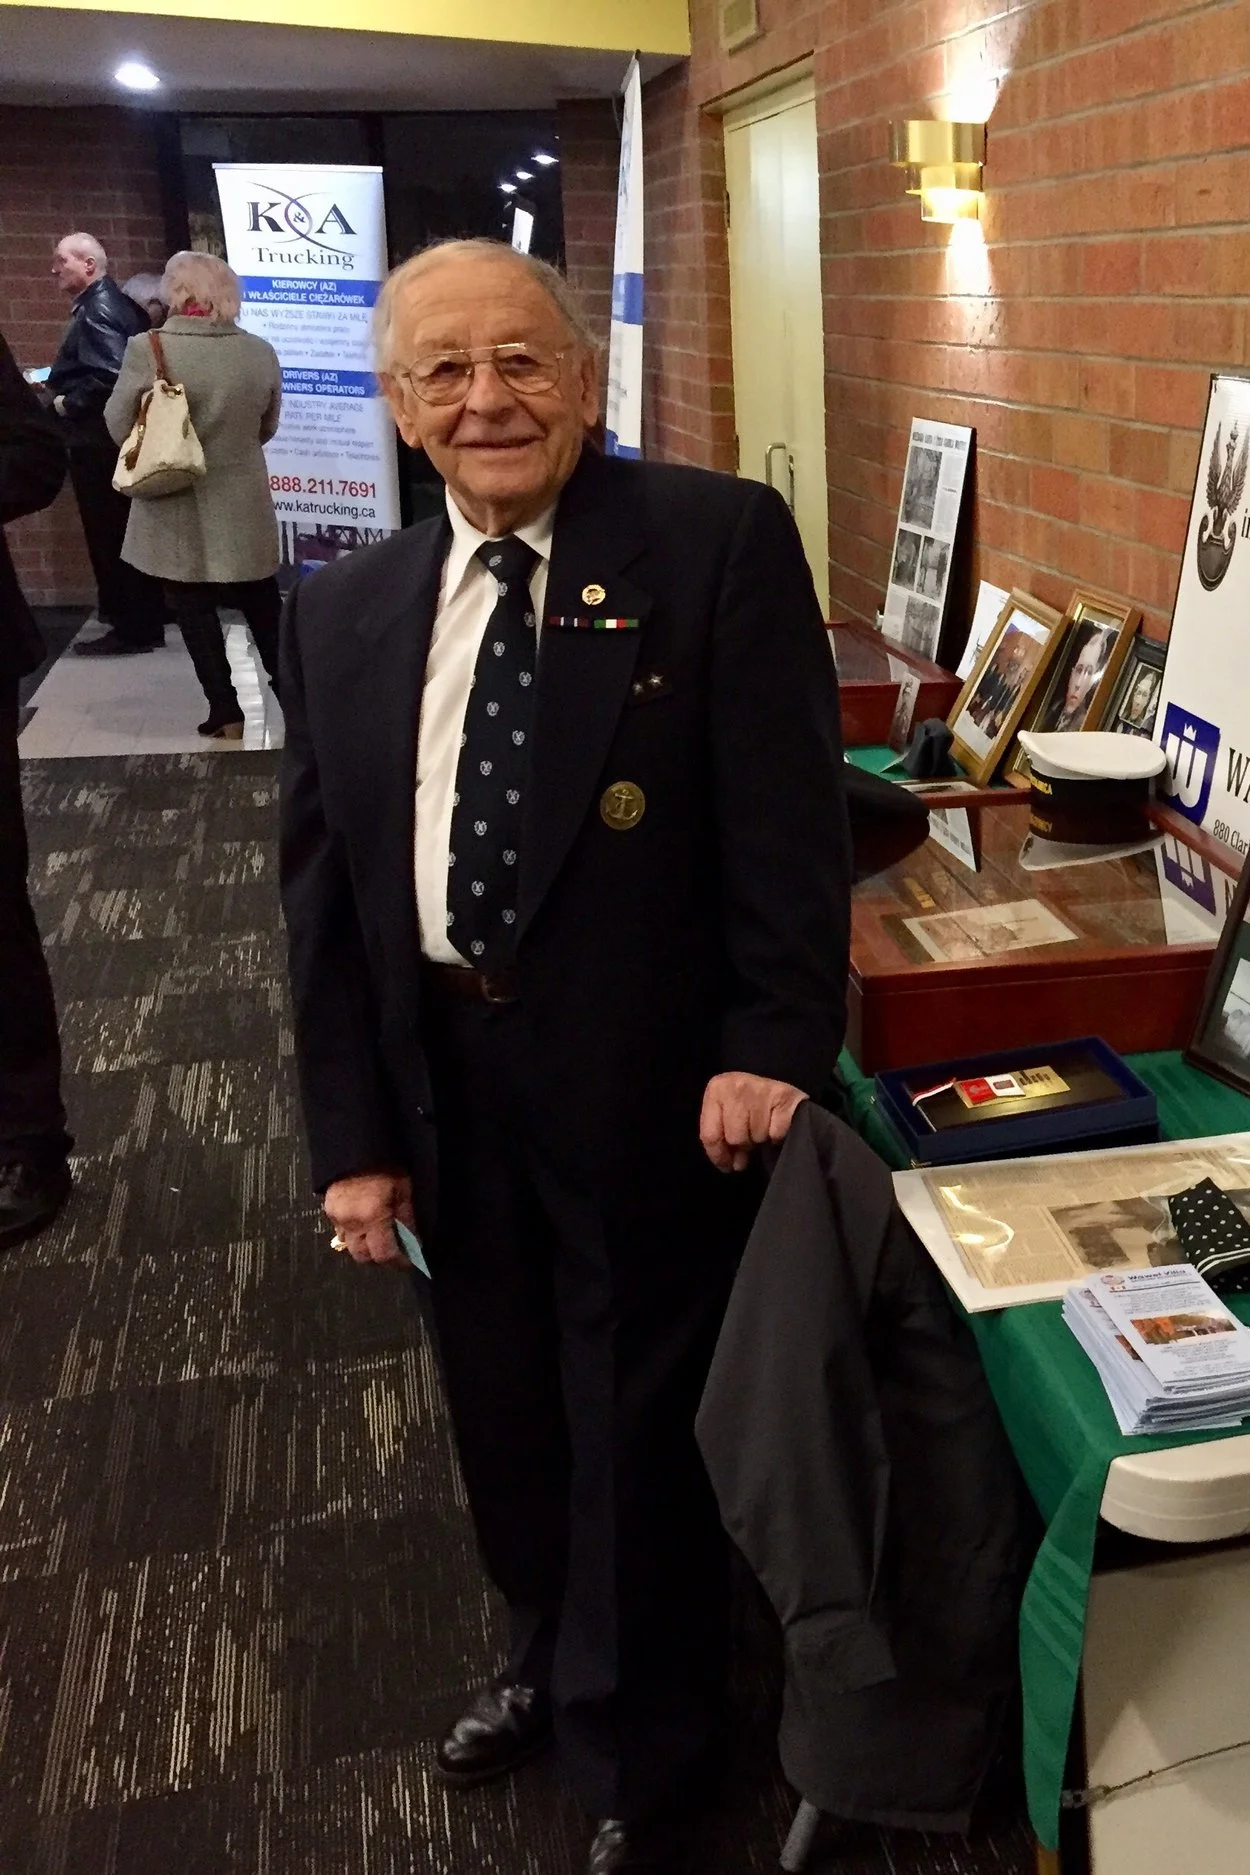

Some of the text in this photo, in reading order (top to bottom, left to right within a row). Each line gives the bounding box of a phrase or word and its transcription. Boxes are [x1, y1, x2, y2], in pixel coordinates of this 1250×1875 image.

[252, 247, 355, 271] Trucking
[272, 279, 337, 292] KIEROWCY (AZ)
[283, 370, 338, 383] DRIVERS (AZ)
[282, 383, 365, 395] WNERS OPERATORS
[1213, 819, 1230, 841] 880
